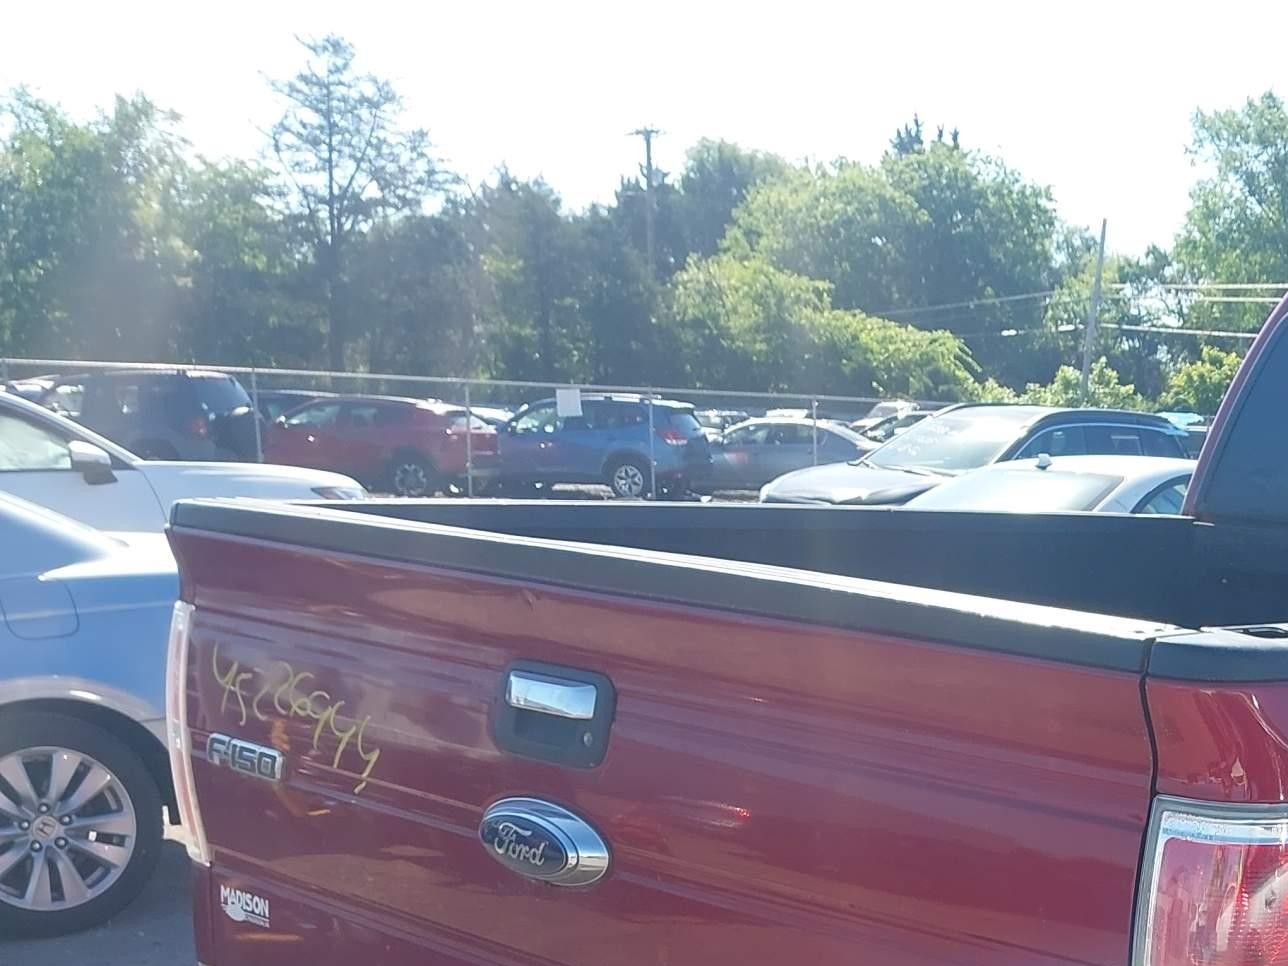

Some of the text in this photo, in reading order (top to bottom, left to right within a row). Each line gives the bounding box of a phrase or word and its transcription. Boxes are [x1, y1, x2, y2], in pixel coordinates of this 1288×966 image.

[212, 641, 381, 795] 45226944
[207, 732, 284, 782] F-150
[494, 821, 549, 867] Ford
[220, 884, 270, 919] MADISON
